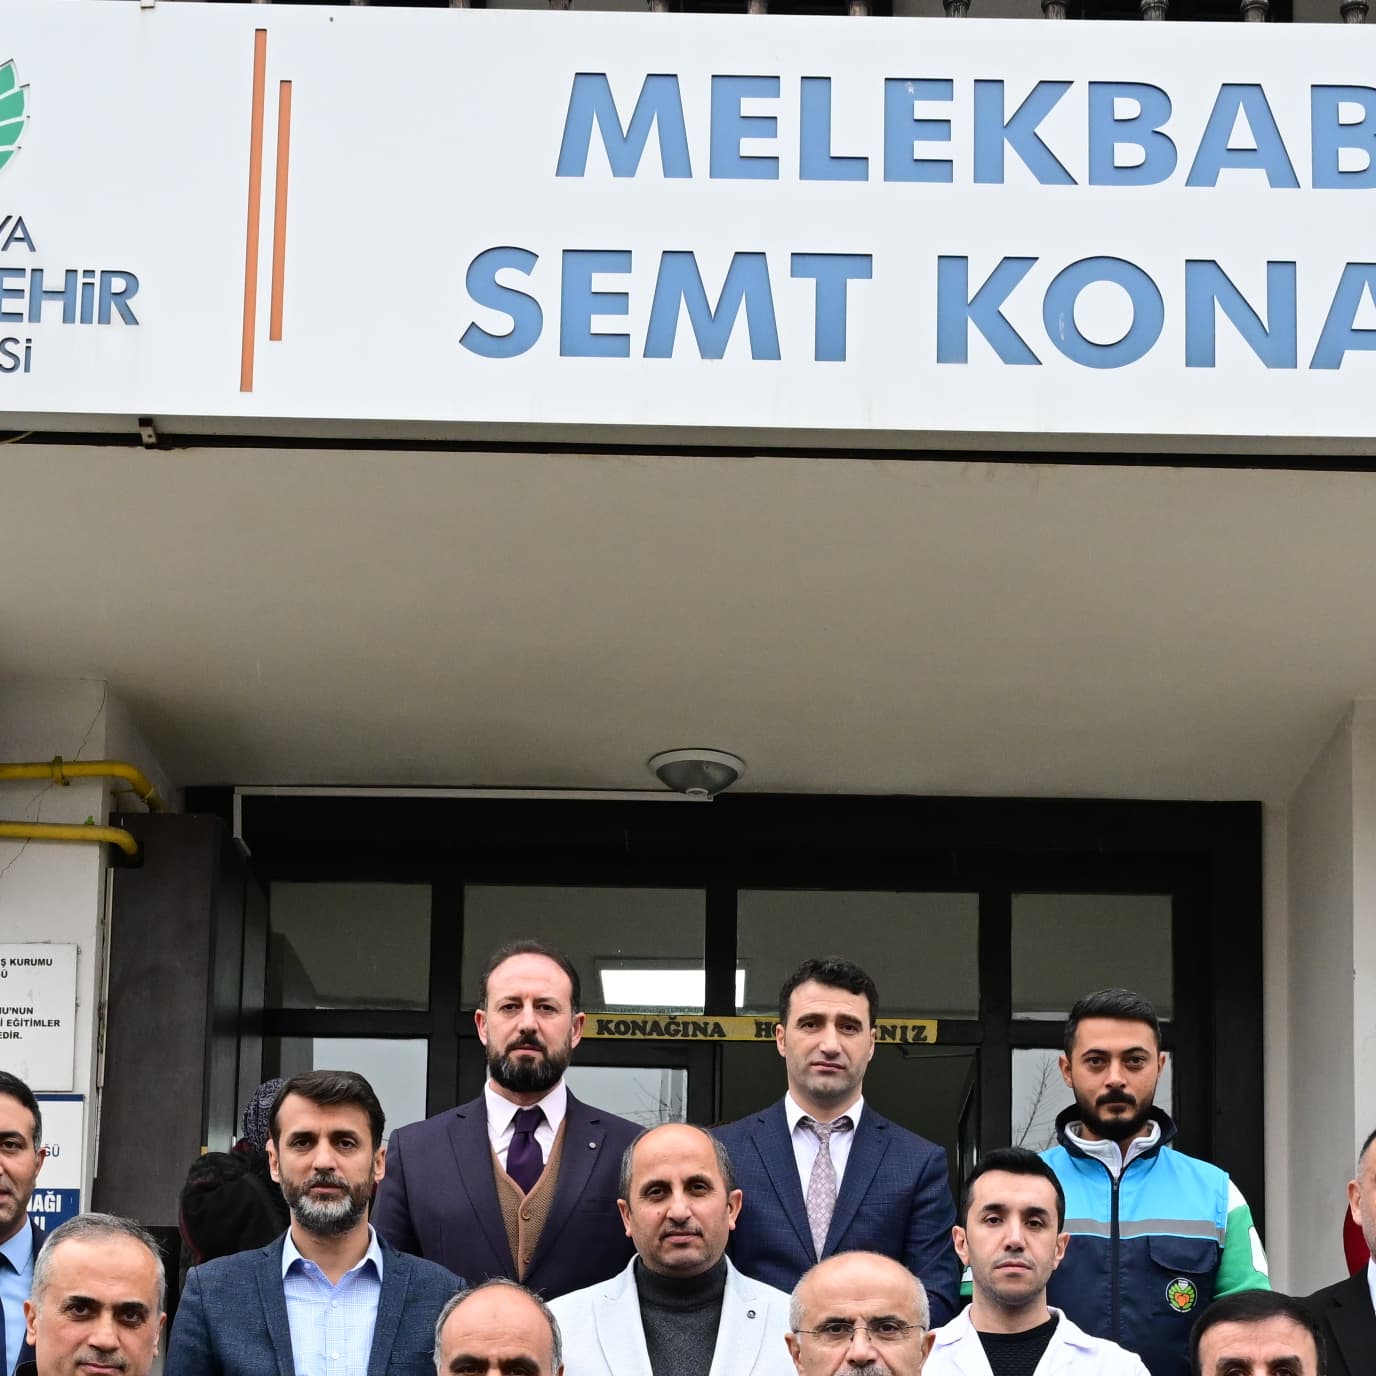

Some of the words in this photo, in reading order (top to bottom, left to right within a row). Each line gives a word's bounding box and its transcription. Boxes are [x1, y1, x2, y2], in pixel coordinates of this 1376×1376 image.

[458, 245, 873, 364] SEMT
[10, 958, 53, 967] KURUMU
[7, 1018, 60, 1028] EĞİTİMLER
[596, 1017, 727, 1038] KONAĞINA
